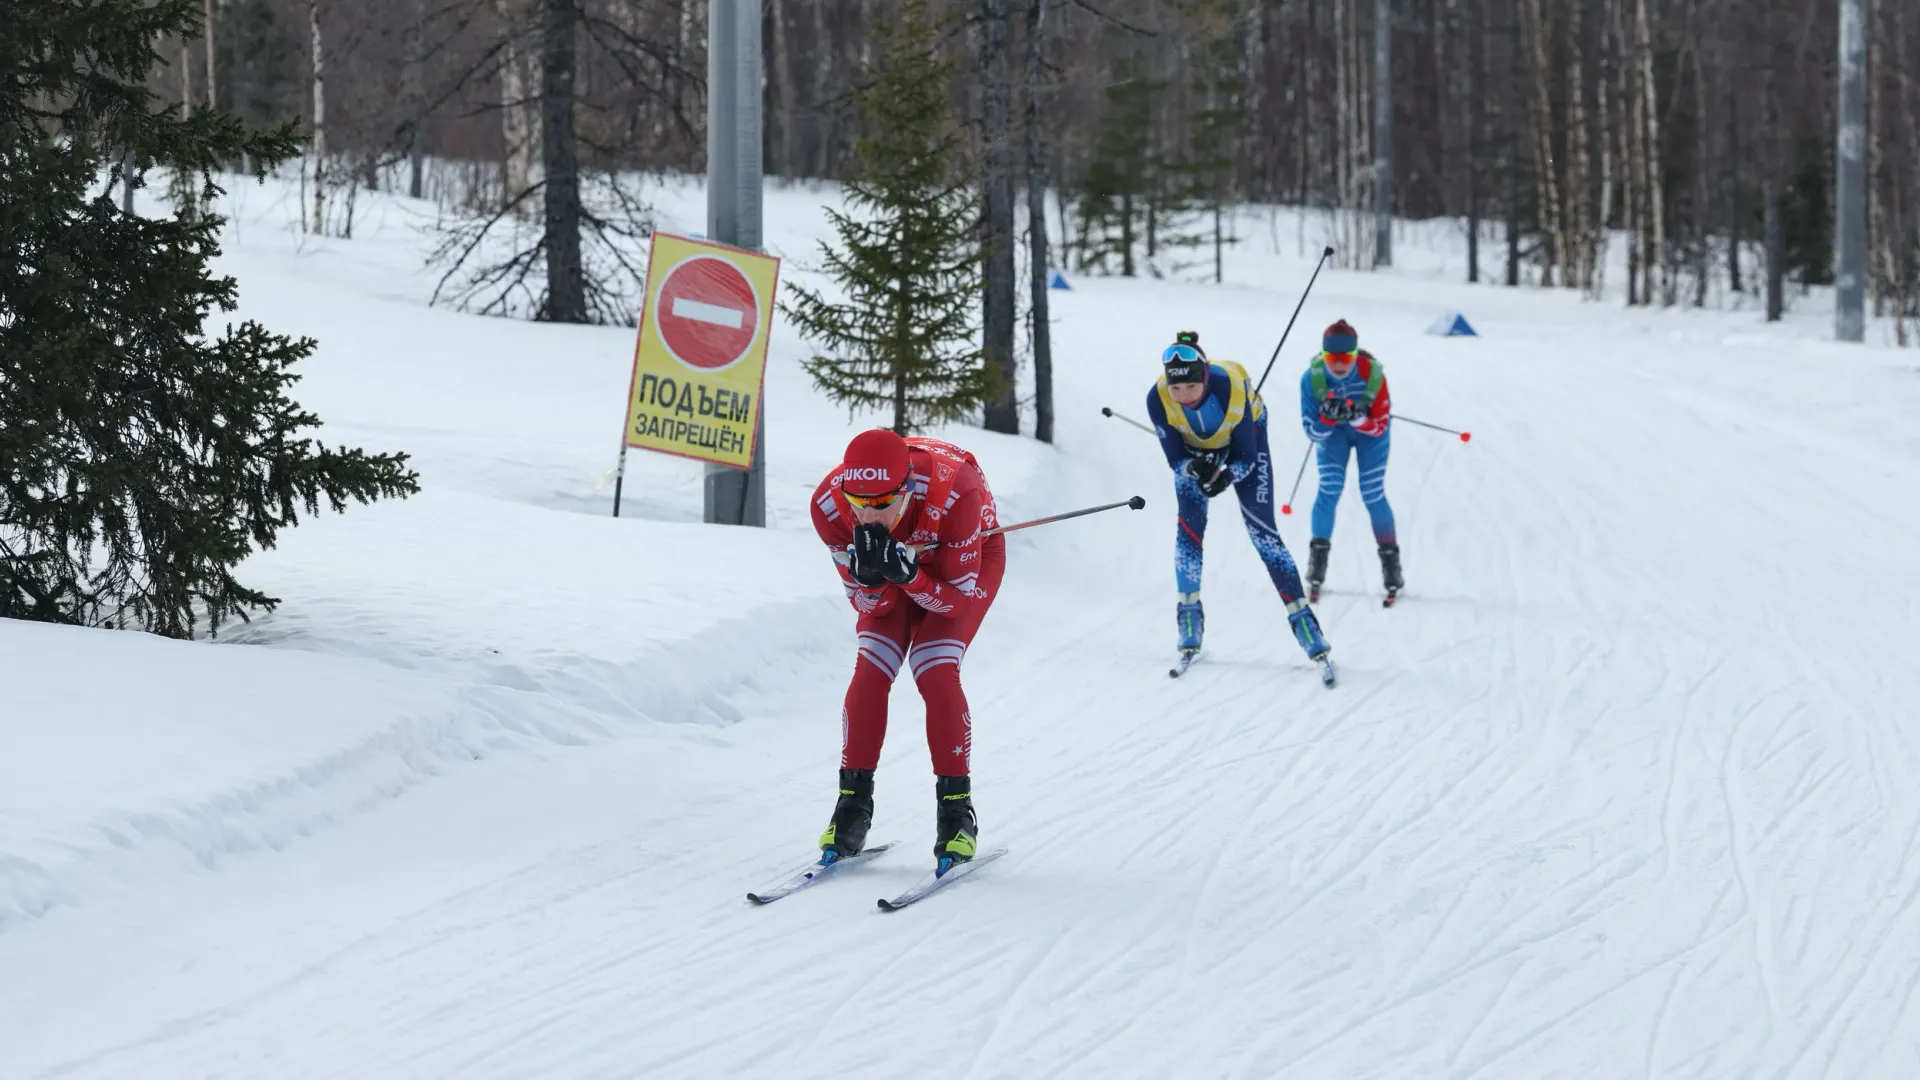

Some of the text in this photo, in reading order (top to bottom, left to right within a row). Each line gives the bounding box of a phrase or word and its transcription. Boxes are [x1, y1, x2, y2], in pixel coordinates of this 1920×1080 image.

[639, 373, 751, 424] ПОДЪЕМ
[635, 413, 745, 454] ЗАПРЕЩЁН
[1256, 452, 1268, 504] ЯМАЛ
